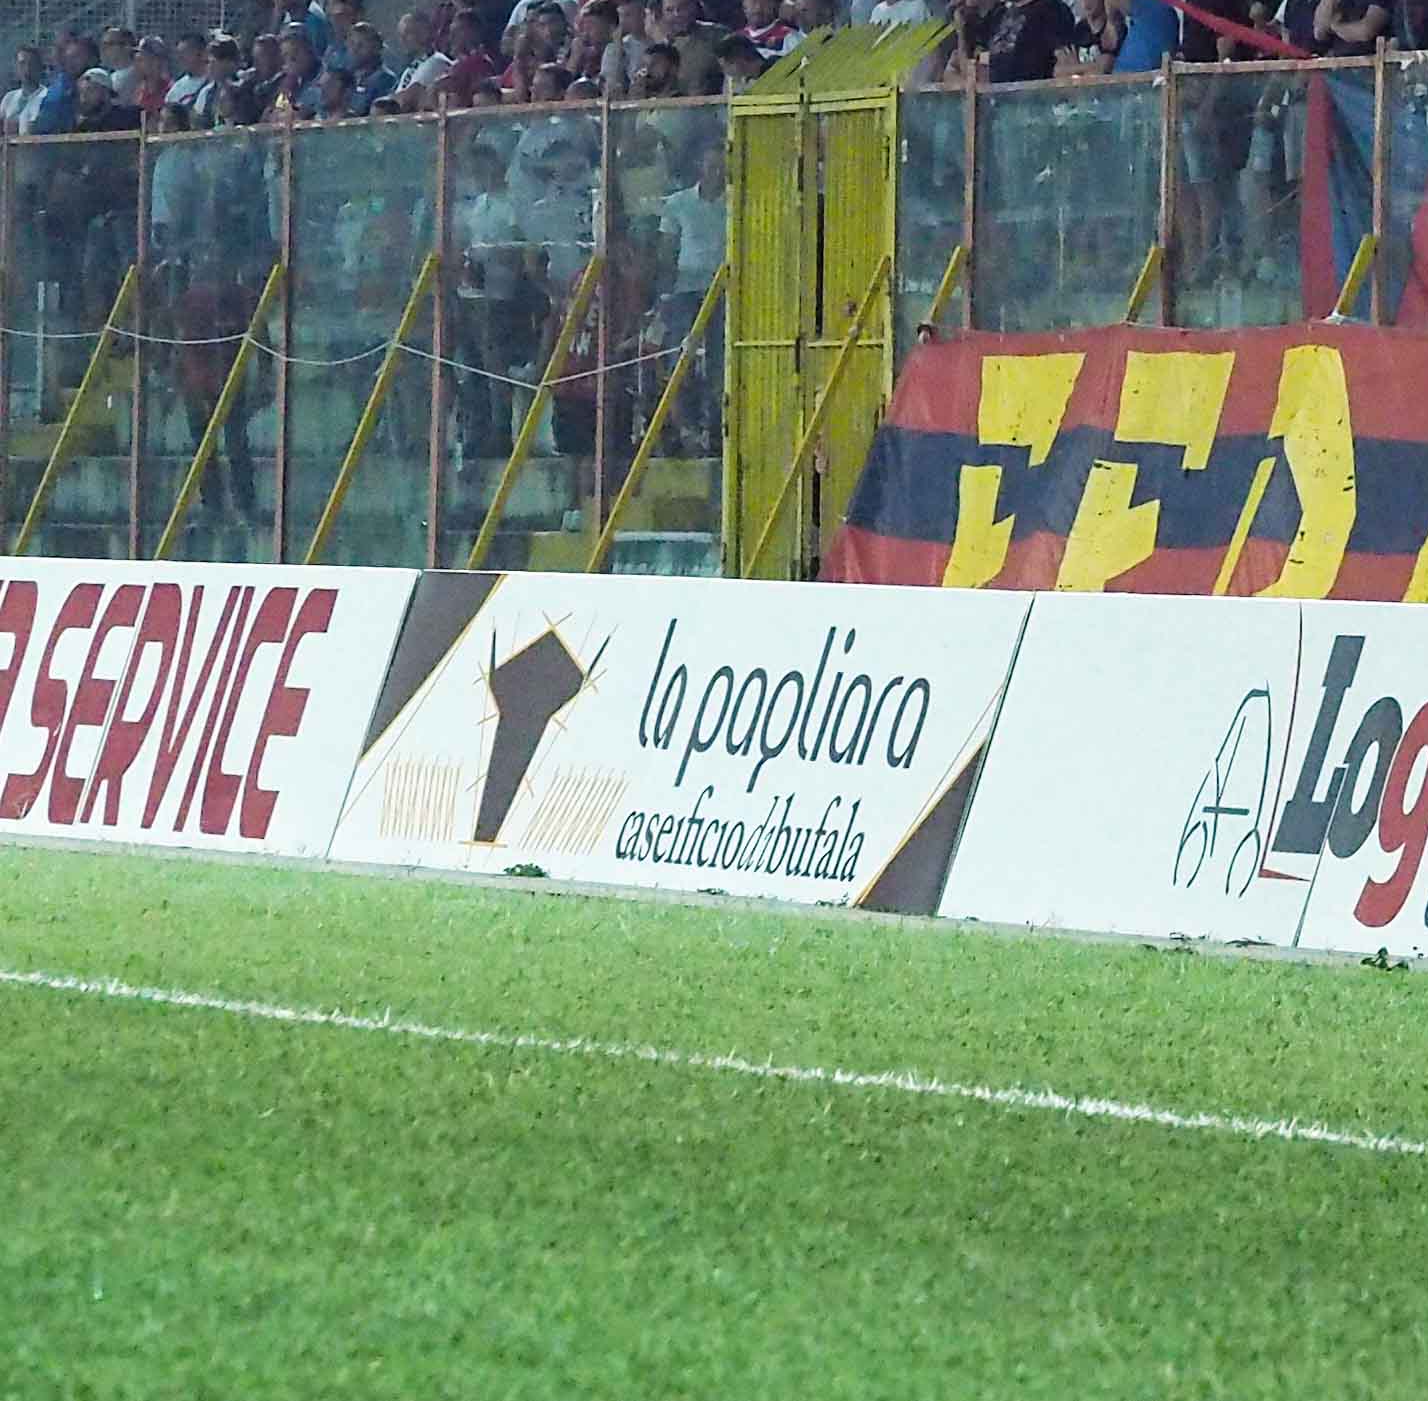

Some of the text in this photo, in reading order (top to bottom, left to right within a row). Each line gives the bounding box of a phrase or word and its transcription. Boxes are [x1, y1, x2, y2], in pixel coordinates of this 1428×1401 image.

[0, 582, 339, 840] SERVICE
[638, 618, 931, 794] la pagliara
